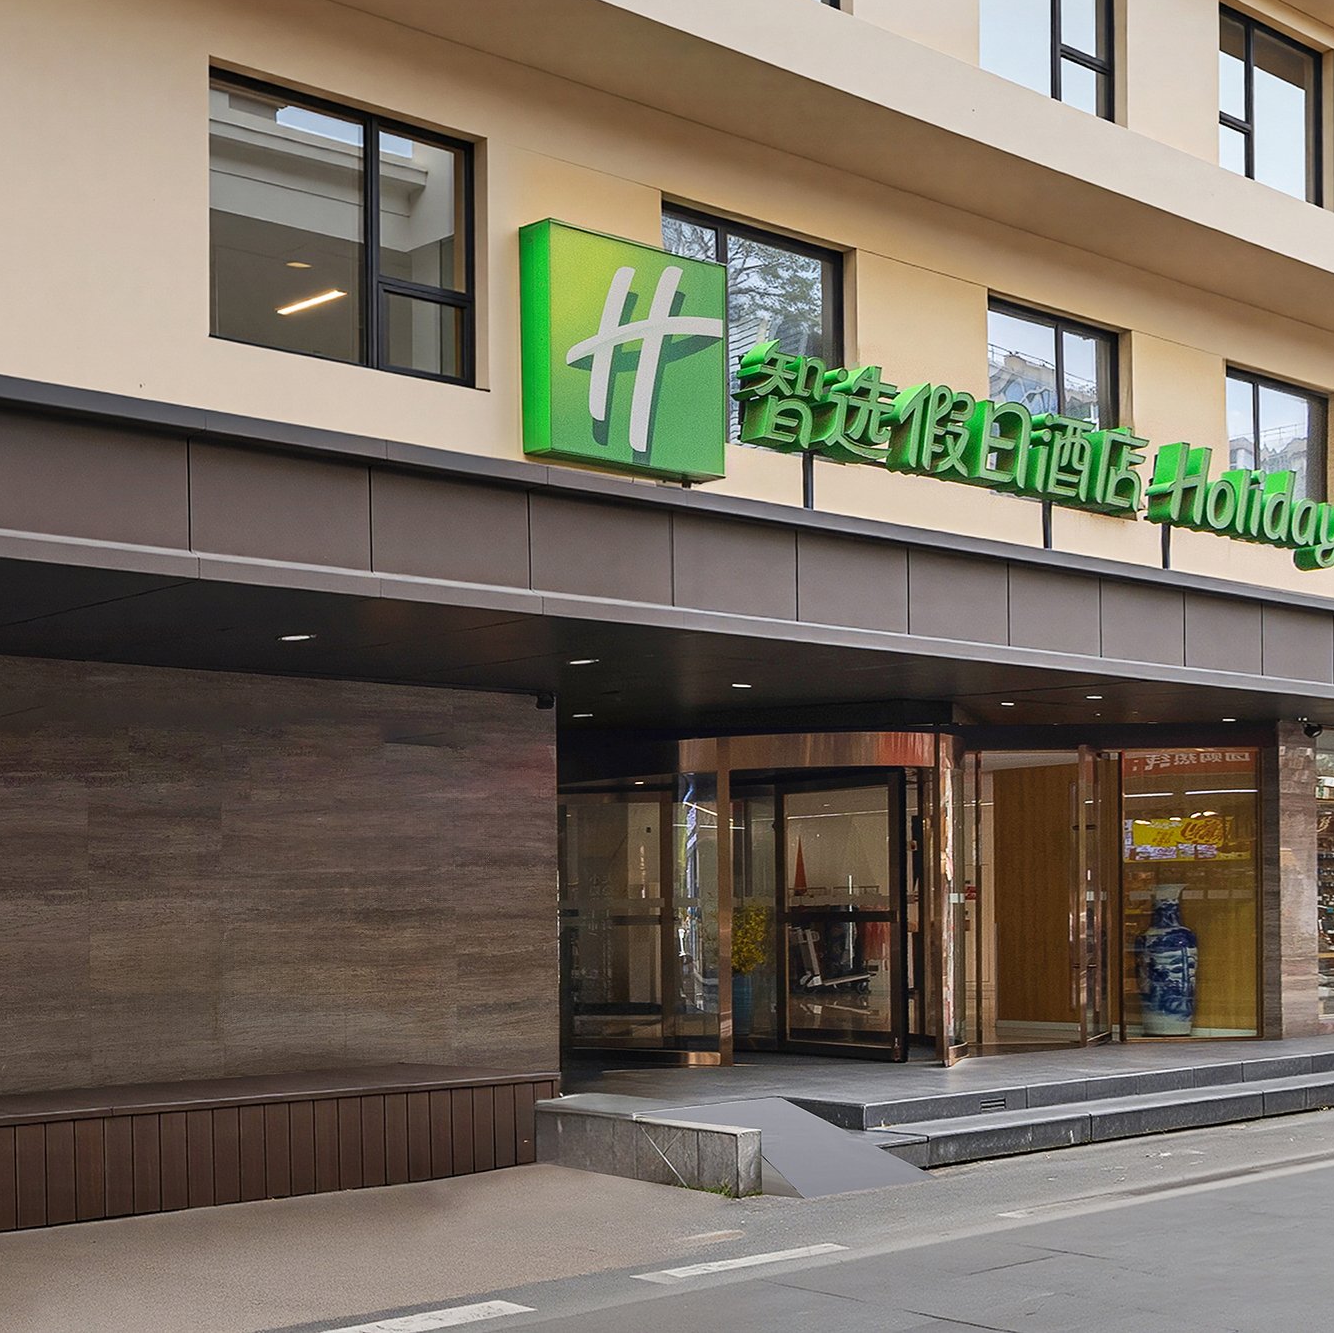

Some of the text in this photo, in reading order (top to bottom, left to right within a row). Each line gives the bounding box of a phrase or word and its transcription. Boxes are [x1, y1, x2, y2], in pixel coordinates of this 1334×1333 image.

[735, 339, 1150, 516] 智选假日酒店
